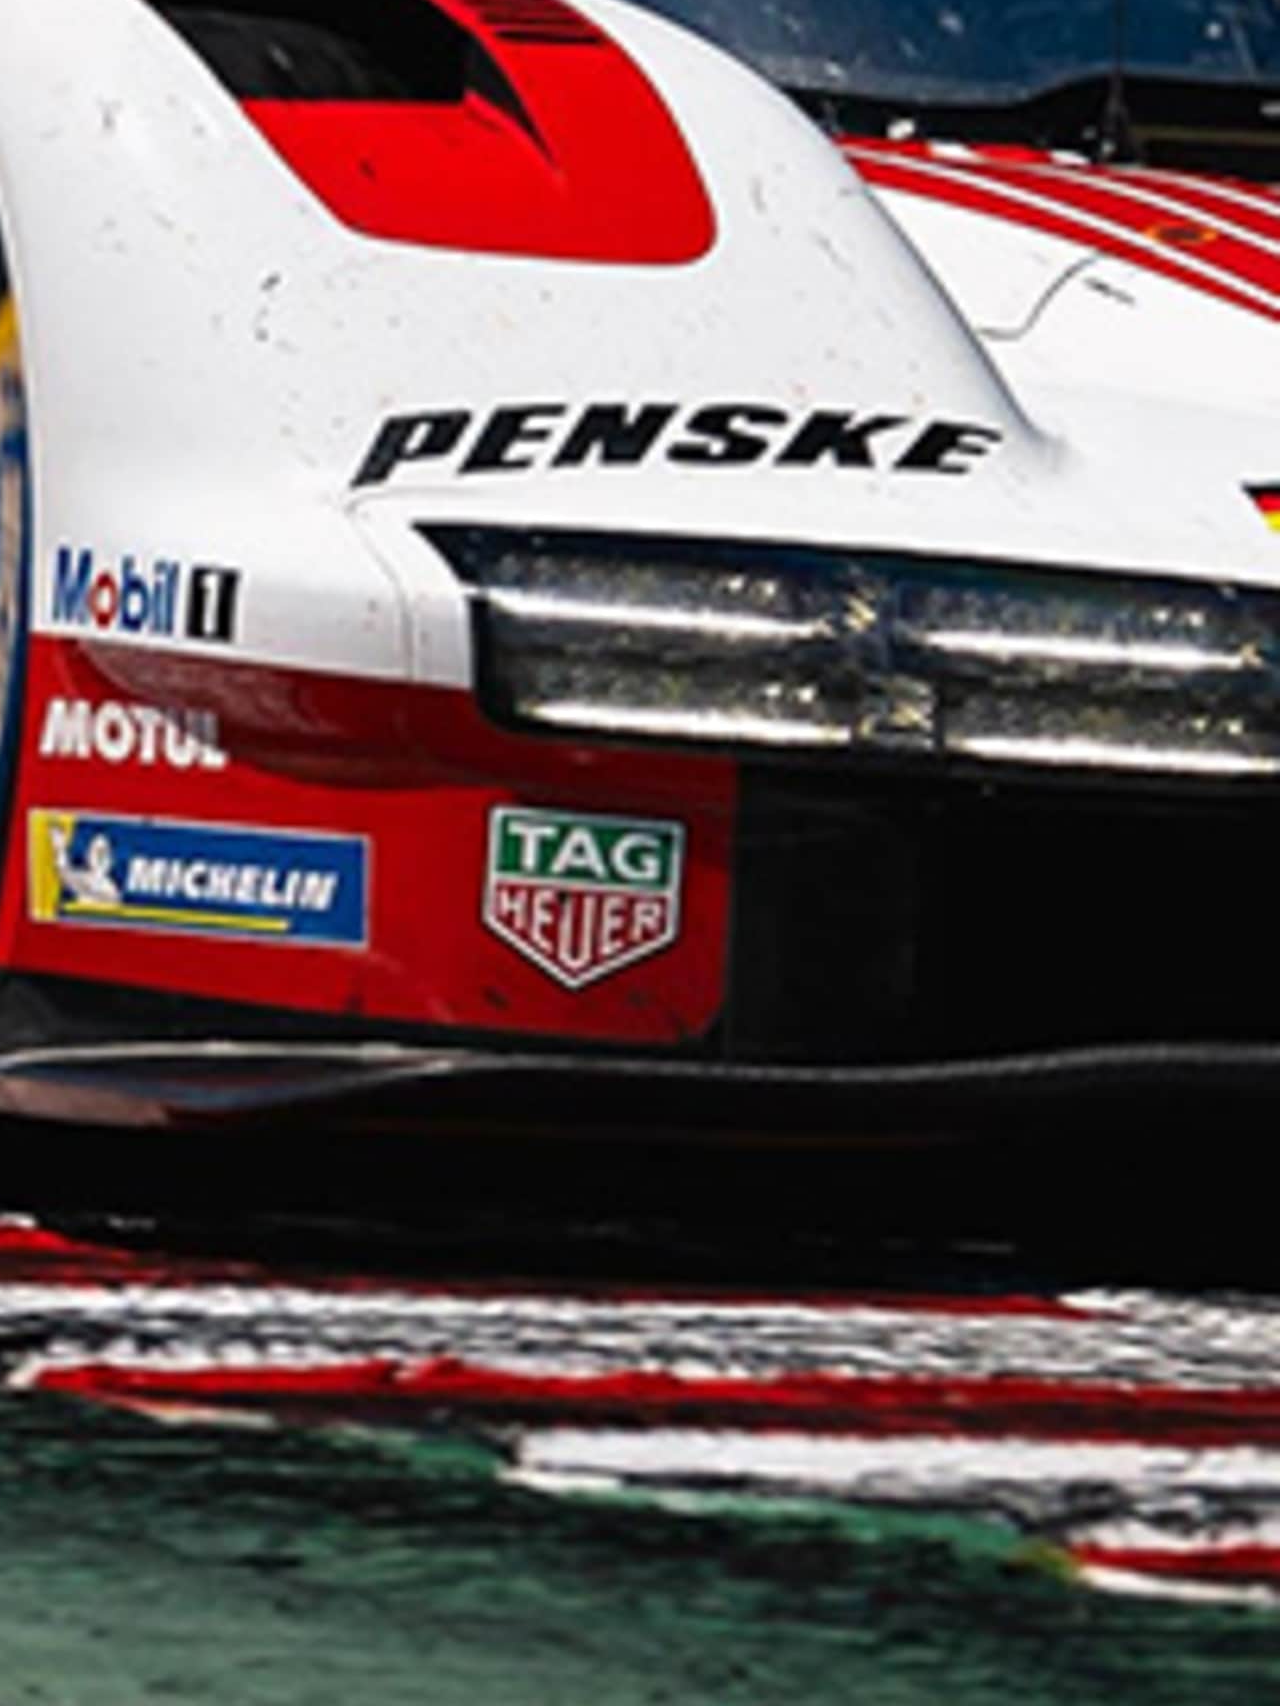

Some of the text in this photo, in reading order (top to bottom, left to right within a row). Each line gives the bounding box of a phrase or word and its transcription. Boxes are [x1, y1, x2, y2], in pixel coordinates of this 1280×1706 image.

[349, 401, 1002, 489] PENSKE
[52, 545, 181, 636] Mobil
[39, 698, 229, 770] MOTUL
[125, 856, 339, 912] MICHELIN
[507, 820, 662, 882] TAG
[498, 888, 664, 968] HEUER
